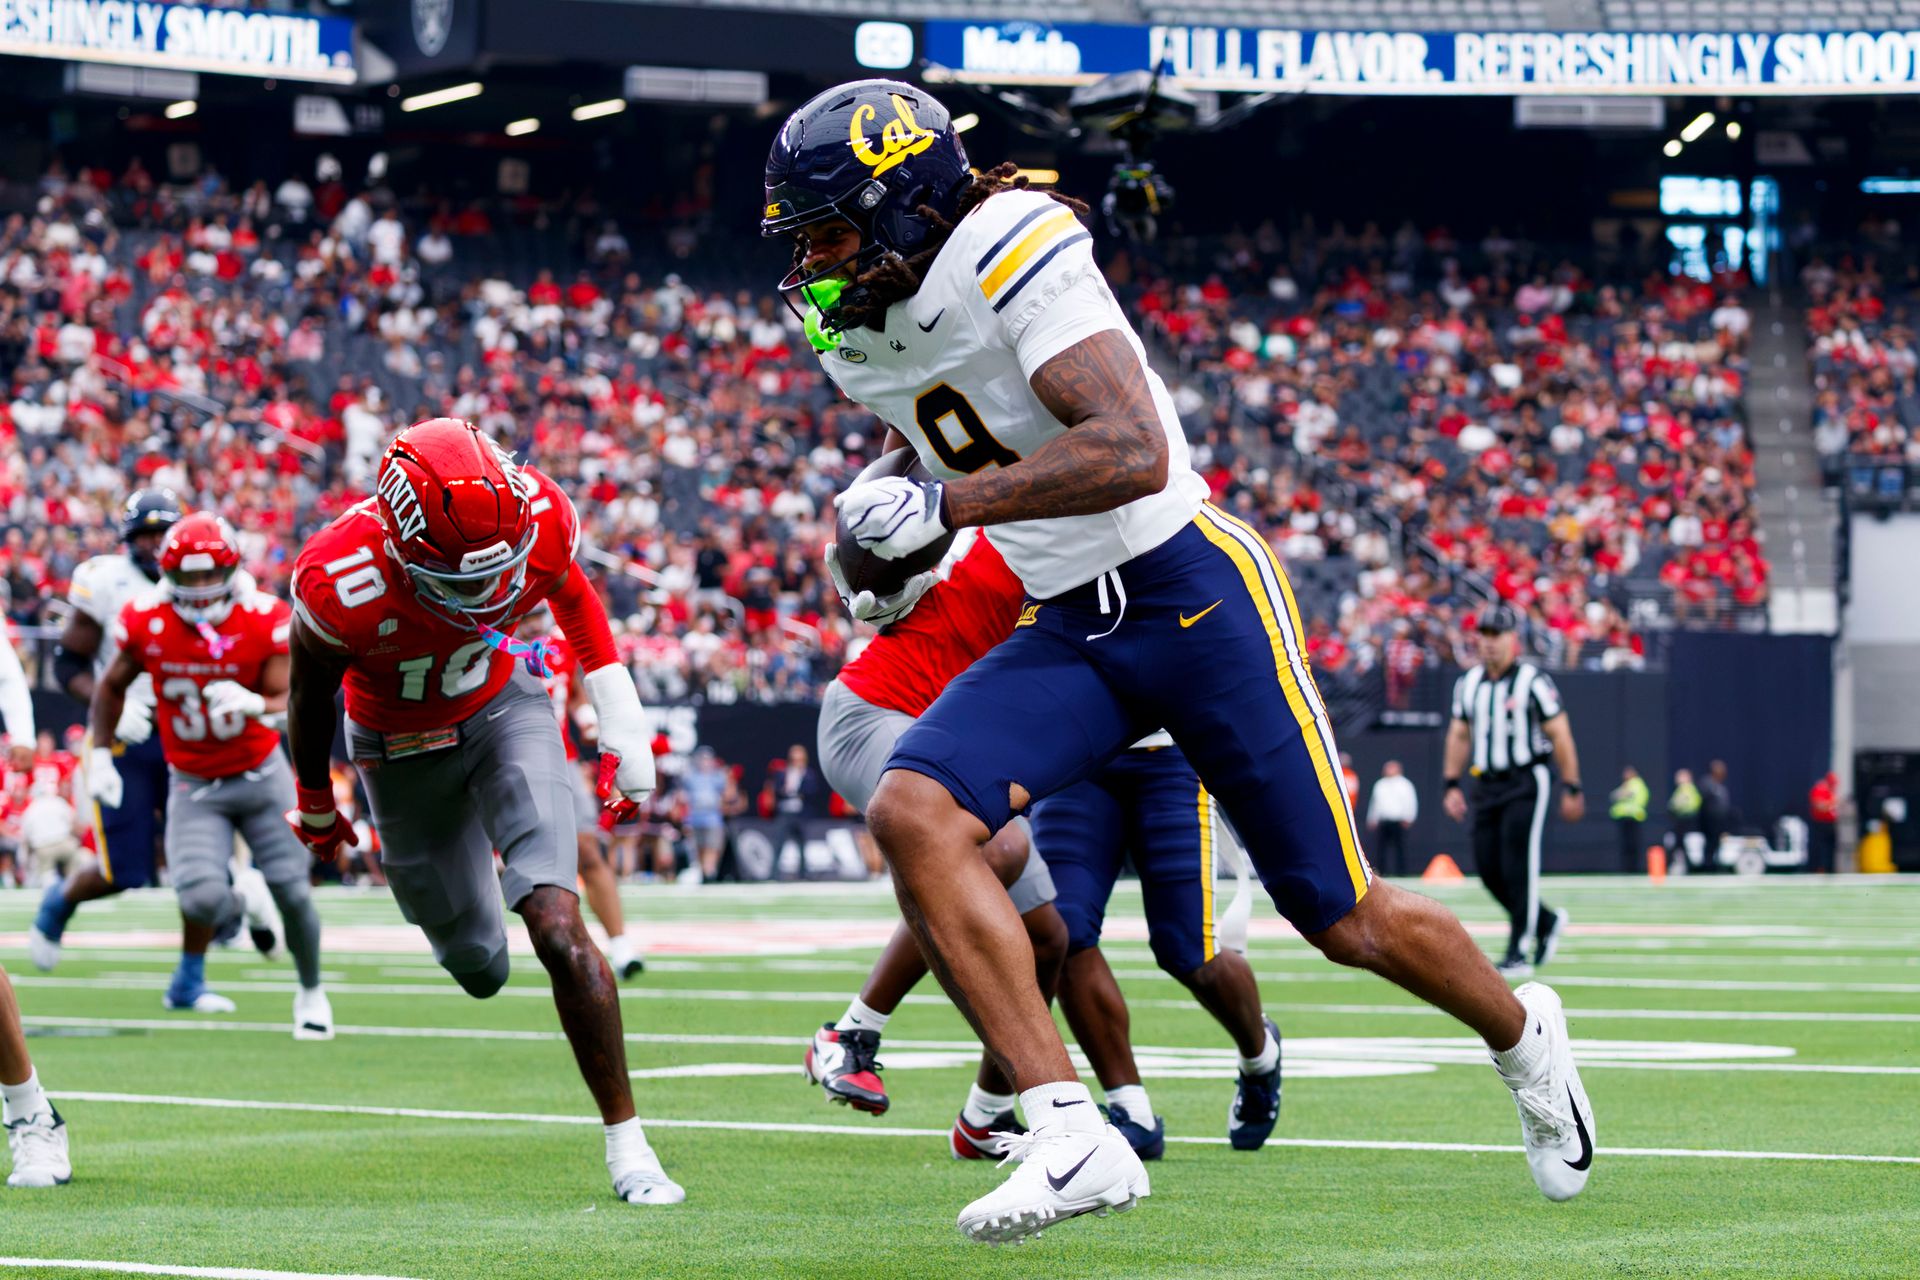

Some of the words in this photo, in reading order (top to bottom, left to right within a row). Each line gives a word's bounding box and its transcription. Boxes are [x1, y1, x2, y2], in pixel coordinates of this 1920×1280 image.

[1454, 31, 1772, 85] REFRESHINGLY
[849, 93, 935, 179] Cal
[914, 380, 1023, 475] 9
[377, 461, 428, 543] UNLV
[324, 546, 389, 609] 10
[467, 547, 508, 566] VEGAS
[398, 638, 494, 701] 10
